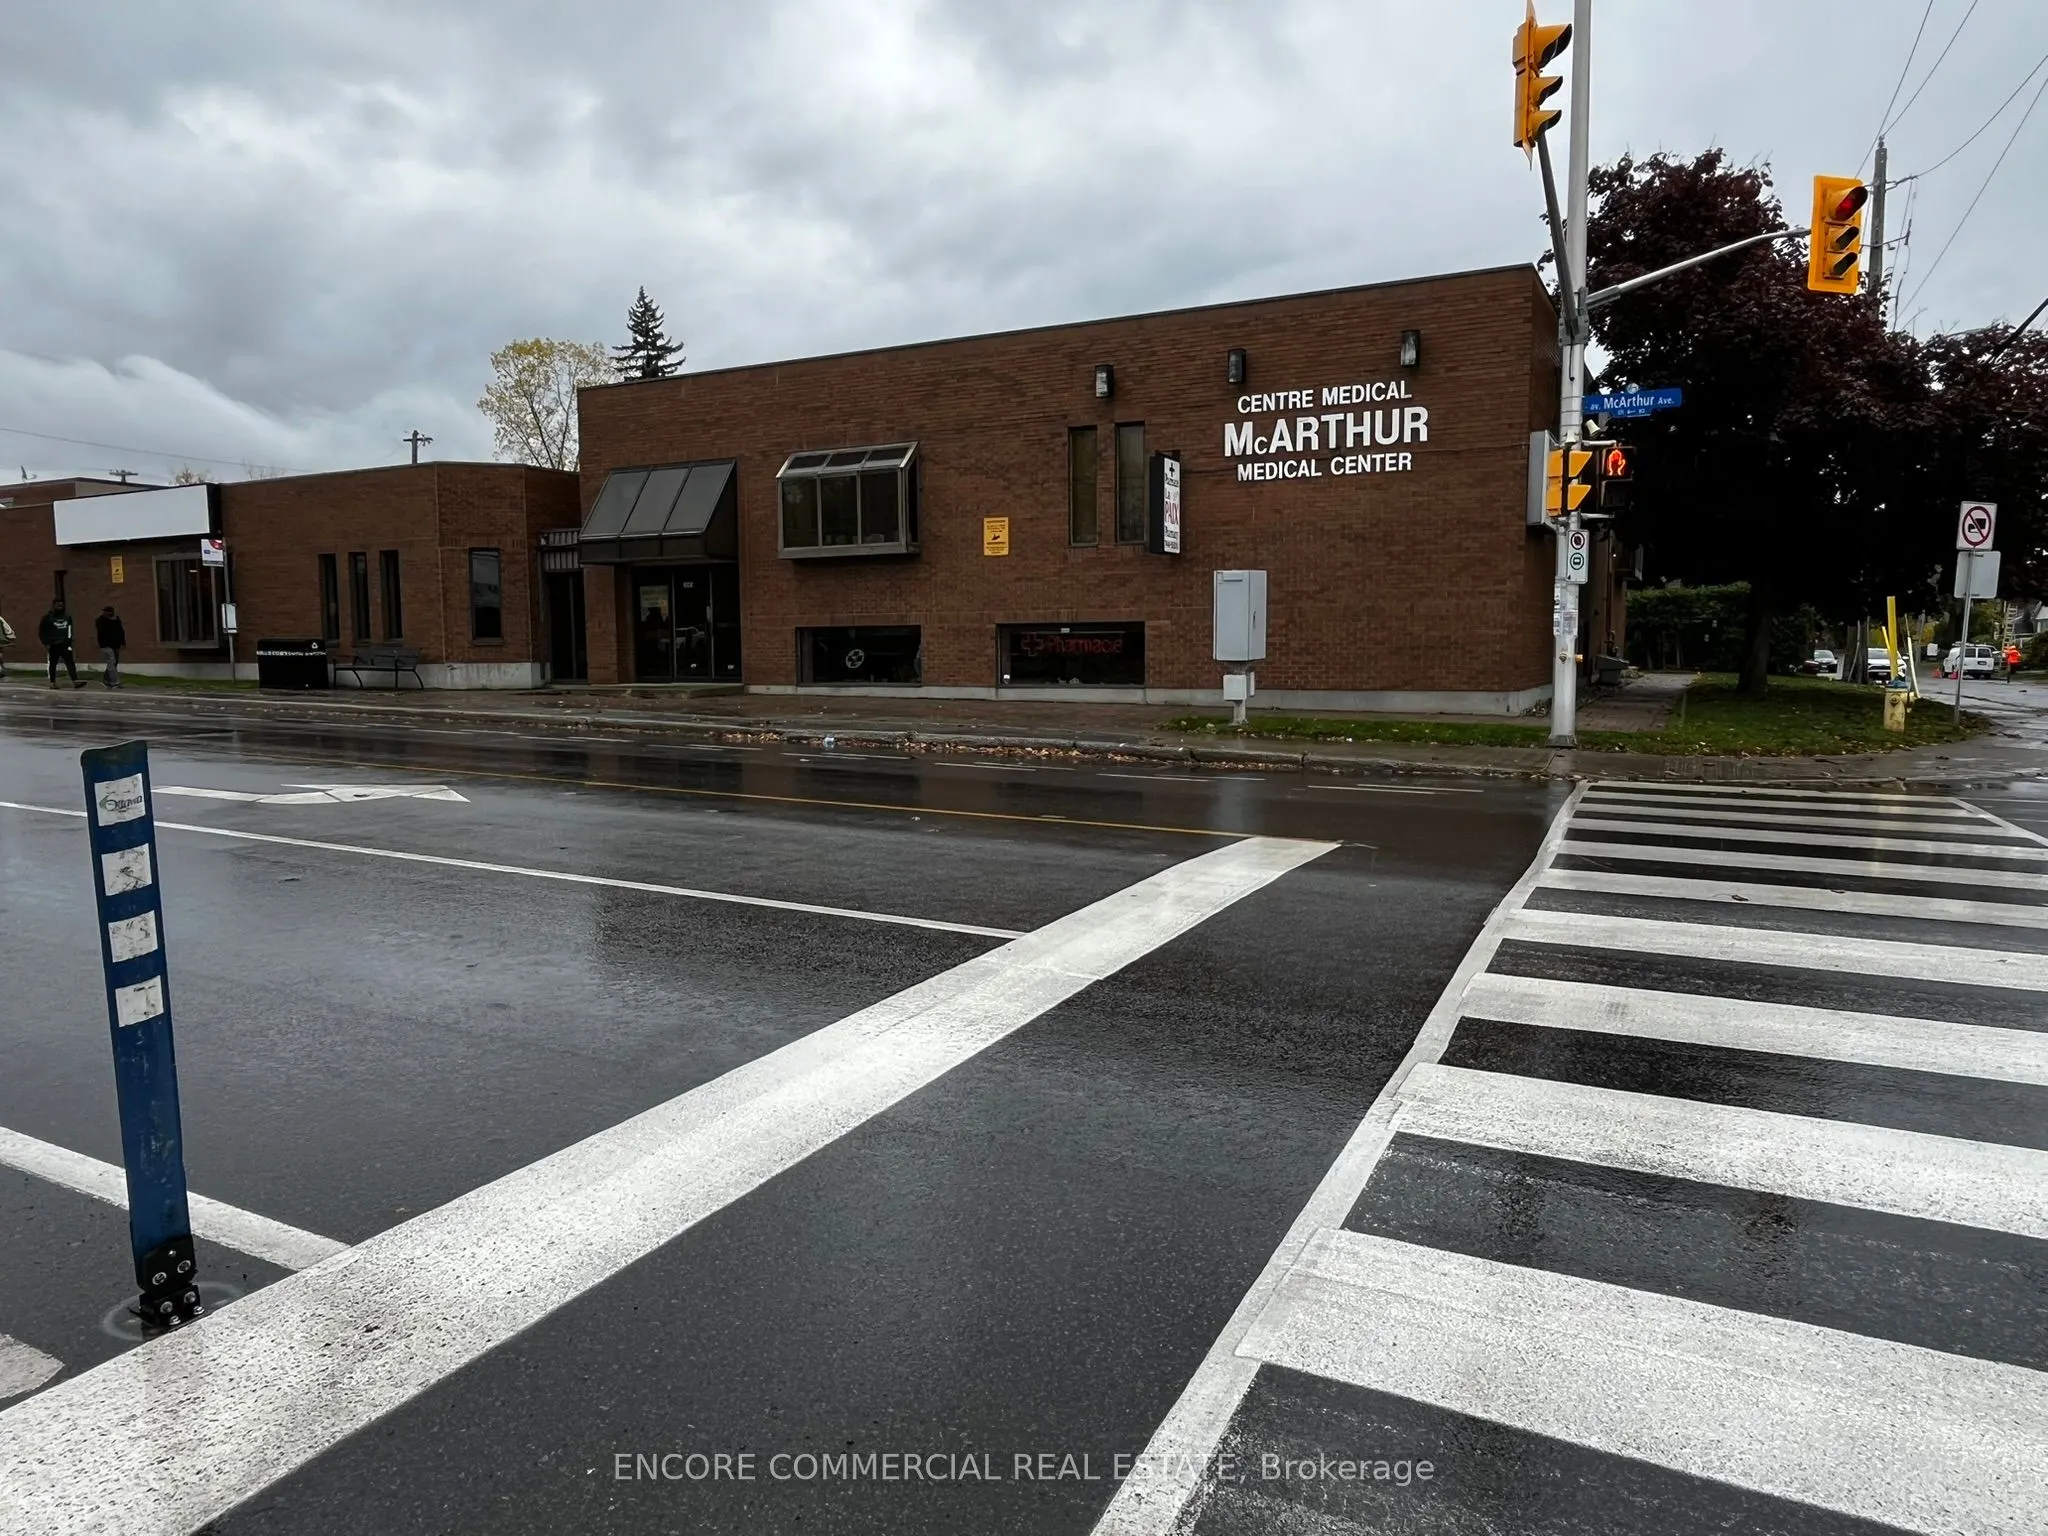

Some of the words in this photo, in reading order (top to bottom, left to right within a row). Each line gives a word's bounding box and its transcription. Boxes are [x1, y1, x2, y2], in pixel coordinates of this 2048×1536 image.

[1237, 389, 1314, 414] CENTRE
[1322, 380, 1412, 406] MEDICAL
[1603, 394, 1655, 410] McArthur
[1657, 396, 1675, 405] Ave.
[1224, 406, 1429, 457] McARTHUR
[1237, 458, 1322, 482] MEDICAL
[1330, 452, 1412, 476] CENTER
[1047, 635, 1122, 654] Pharmacie
